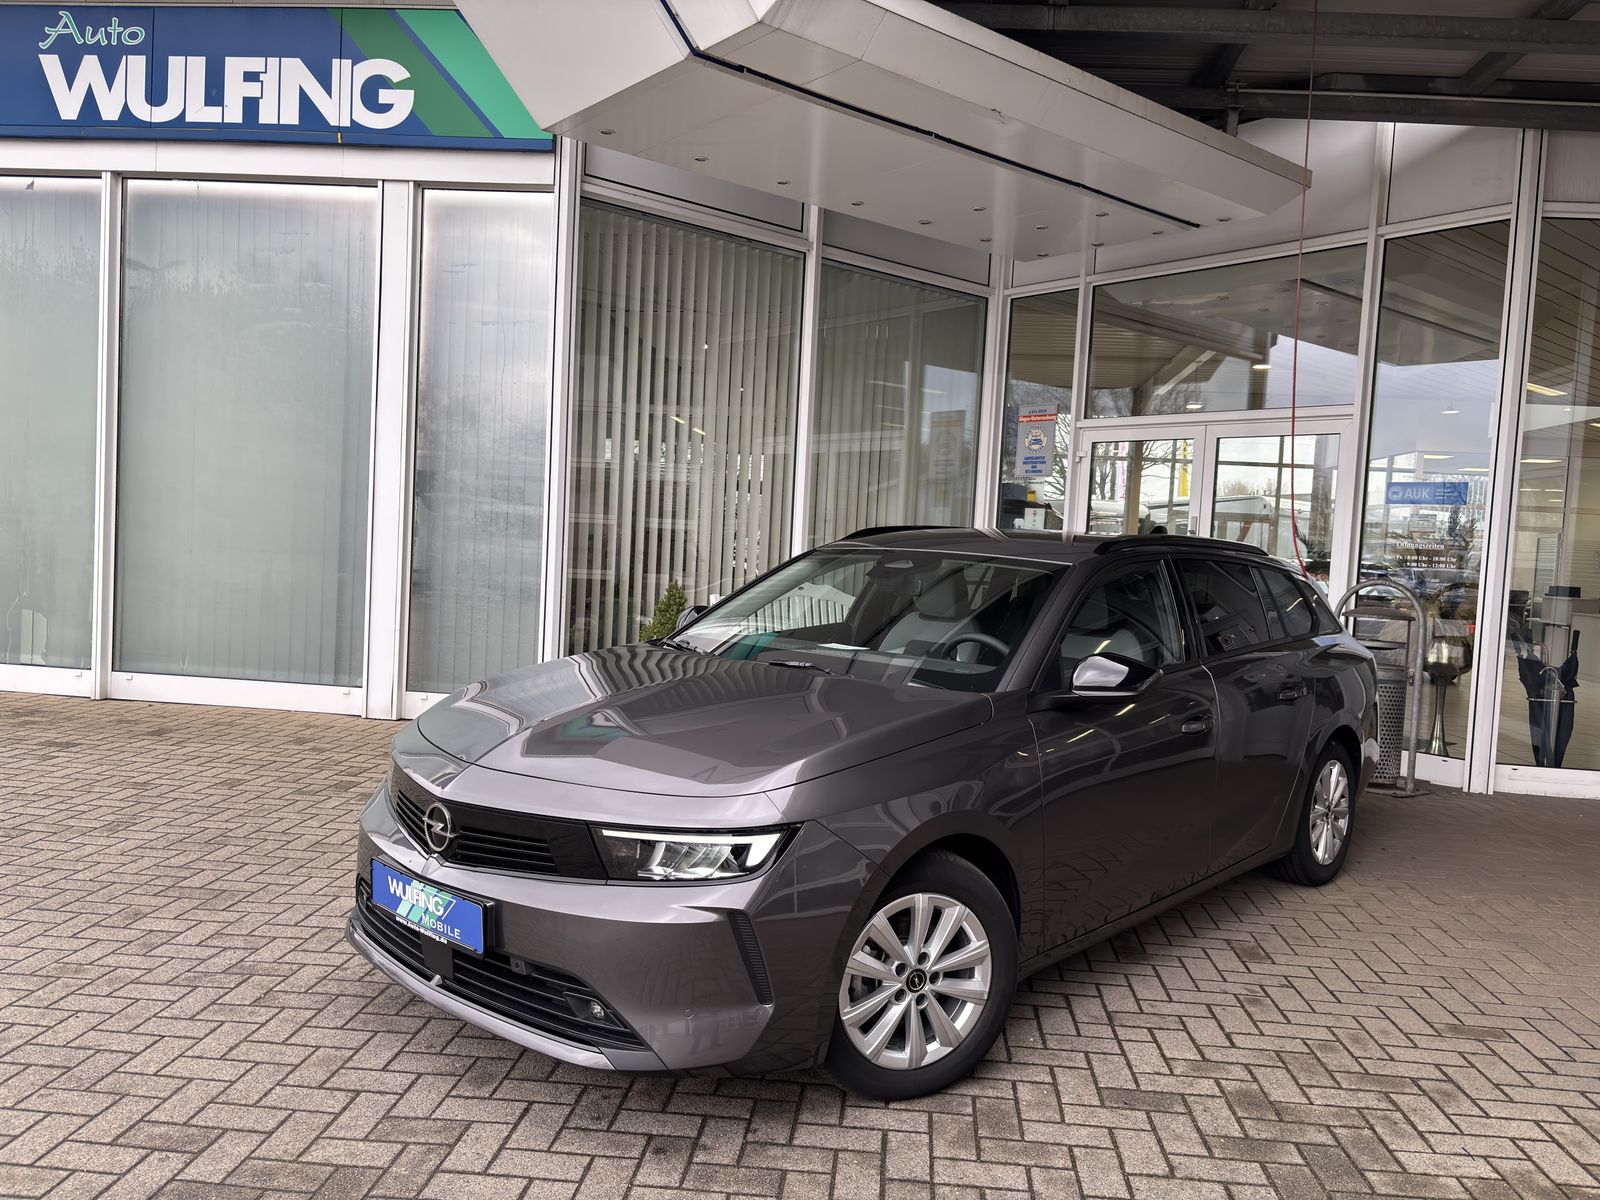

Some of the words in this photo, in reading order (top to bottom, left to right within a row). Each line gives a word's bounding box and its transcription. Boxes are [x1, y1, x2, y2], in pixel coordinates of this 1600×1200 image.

[38, 11, 146, 50] Auto
[38, 54, 415, 130] WULFING
[1404, 488, 1430, 499] AUK
[388, 875, 445, 916] WULFING
[421, 913, 461, 939] MOBILE
